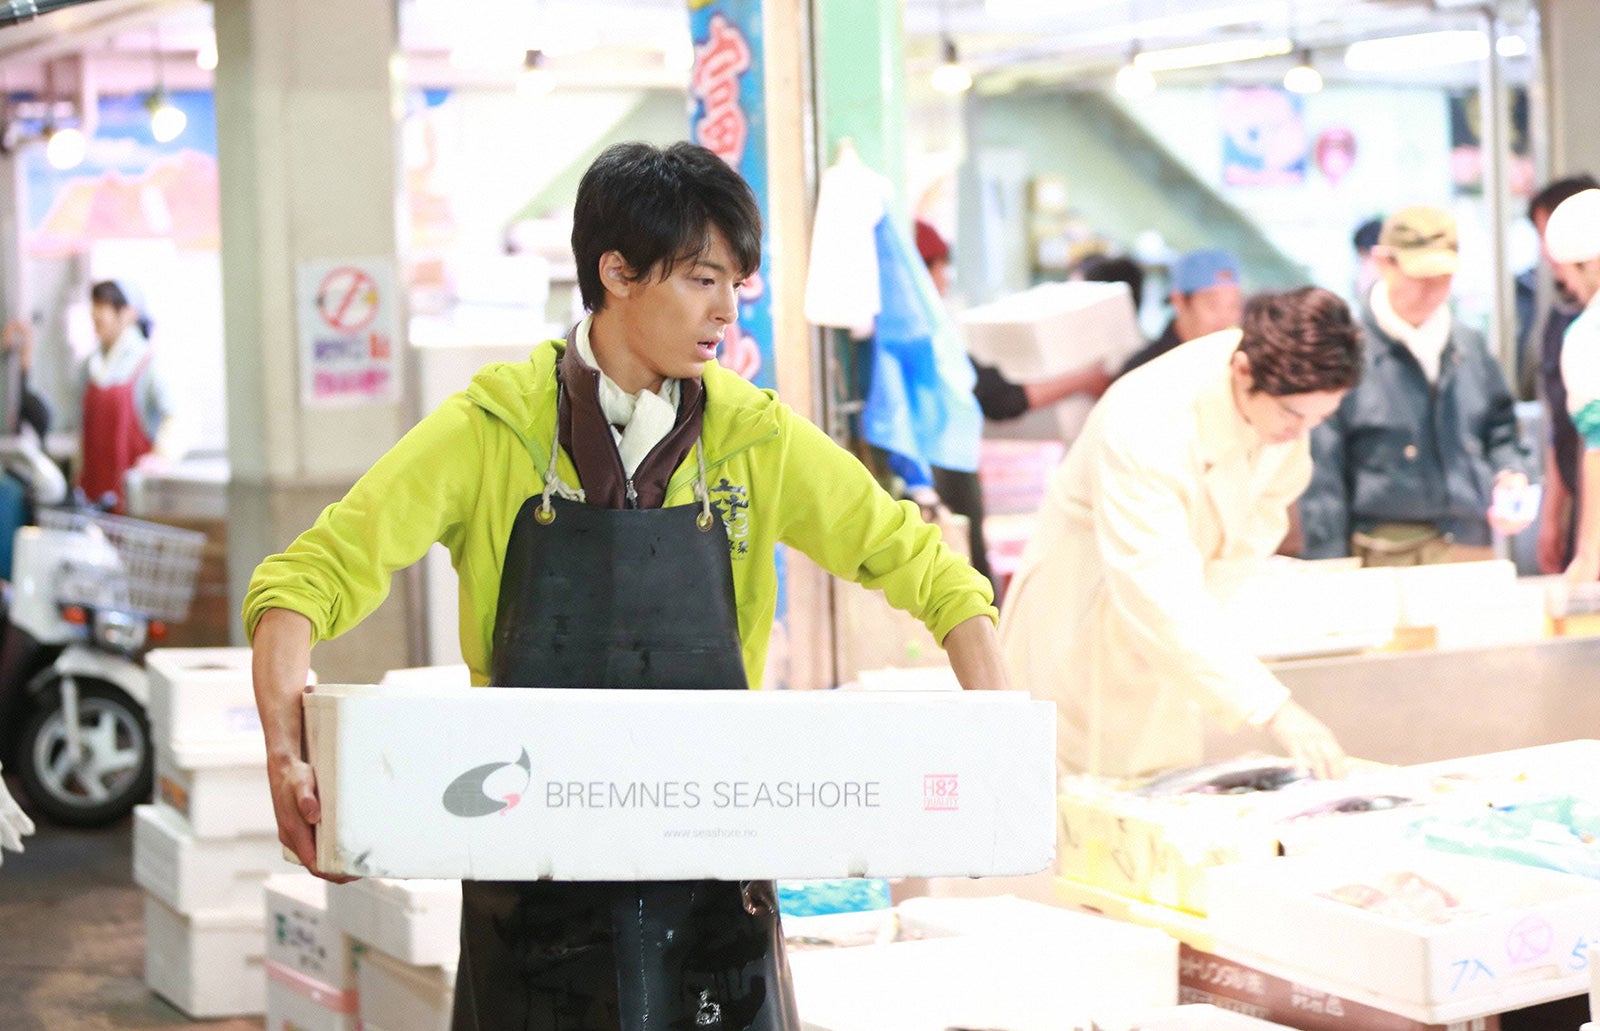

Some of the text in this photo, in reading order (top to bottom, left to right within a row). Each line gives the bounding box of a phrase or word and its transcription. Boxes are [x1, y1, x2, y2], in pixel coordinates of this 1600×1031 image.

[545, 781, 881, 809] BREMNES SEASHORE
[923, 779, 959, 797] H82
[663, 827, 758, 839] www.seashore.no
